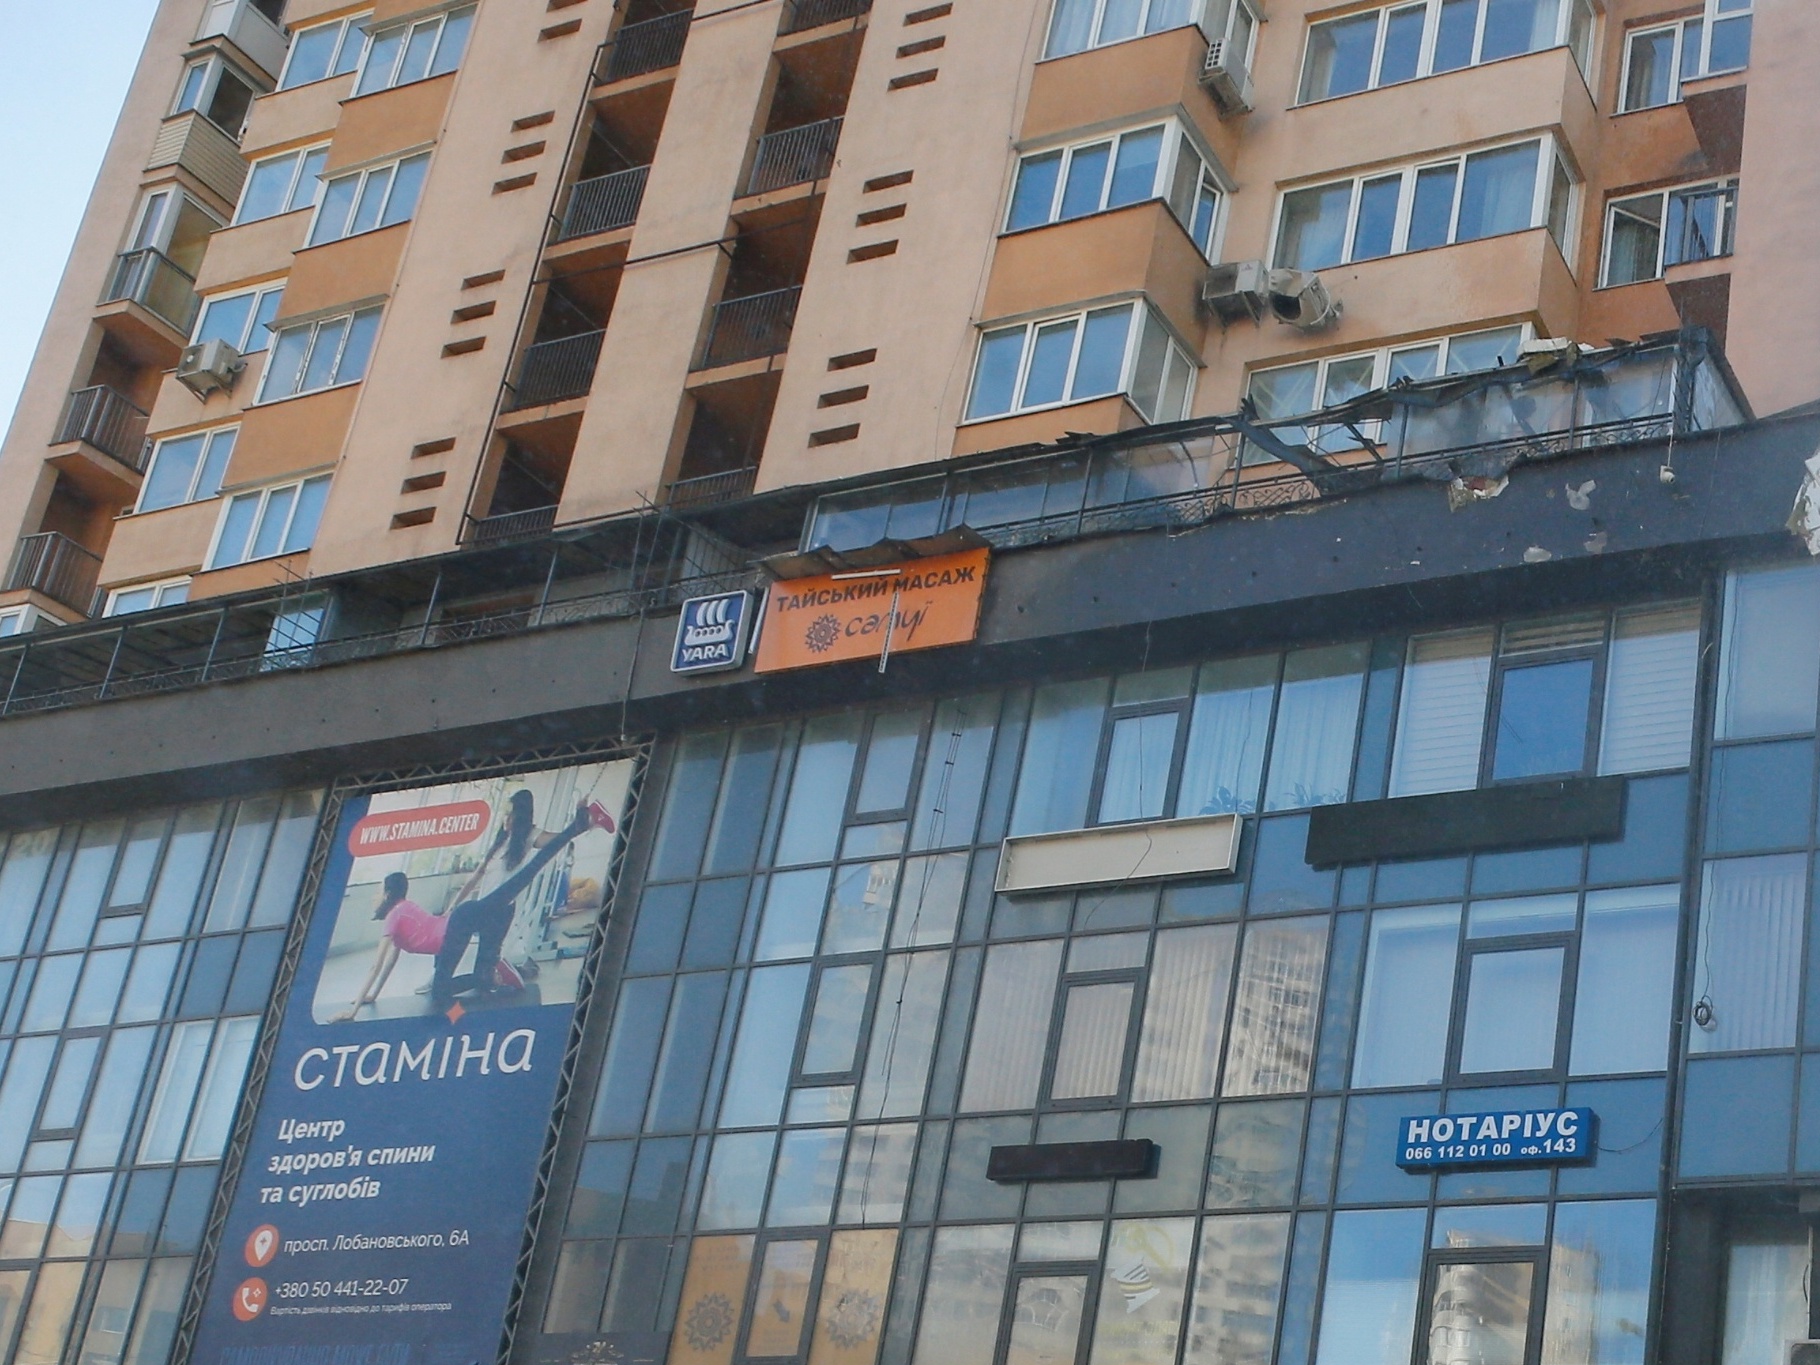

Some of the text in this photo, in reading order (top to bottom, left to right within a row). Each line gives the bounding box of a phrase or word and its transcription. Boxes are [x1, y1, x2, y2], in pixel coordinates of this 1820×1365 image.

[777, 565, 976, 612] ТАЙСЬКИЙ МАСАЖ
[682, 643, 728, 662] YARA
[359, 812, 481, 846] WWW.STAMINA.CENTER
[277, 1117, 345, 1143] Центр
[1407, 1111, 1578, 1143] НОТАРІУС
[267, 1143, 436, 1175] здоров'я спини
[1405, 1146, 1432, 1160] 066
[1438, 1145, 1464, 1159] 112
[1469, 1144, 1486, 1157] 01
[1492, 1143, 1511, 1157] 00
[260, 1175, 381, 1208] та суглобів
[283, 1229, 470, 1256] просп. Лобановського, 6А
[275, 1278, 409, 1299] +380 50 441-22-07
